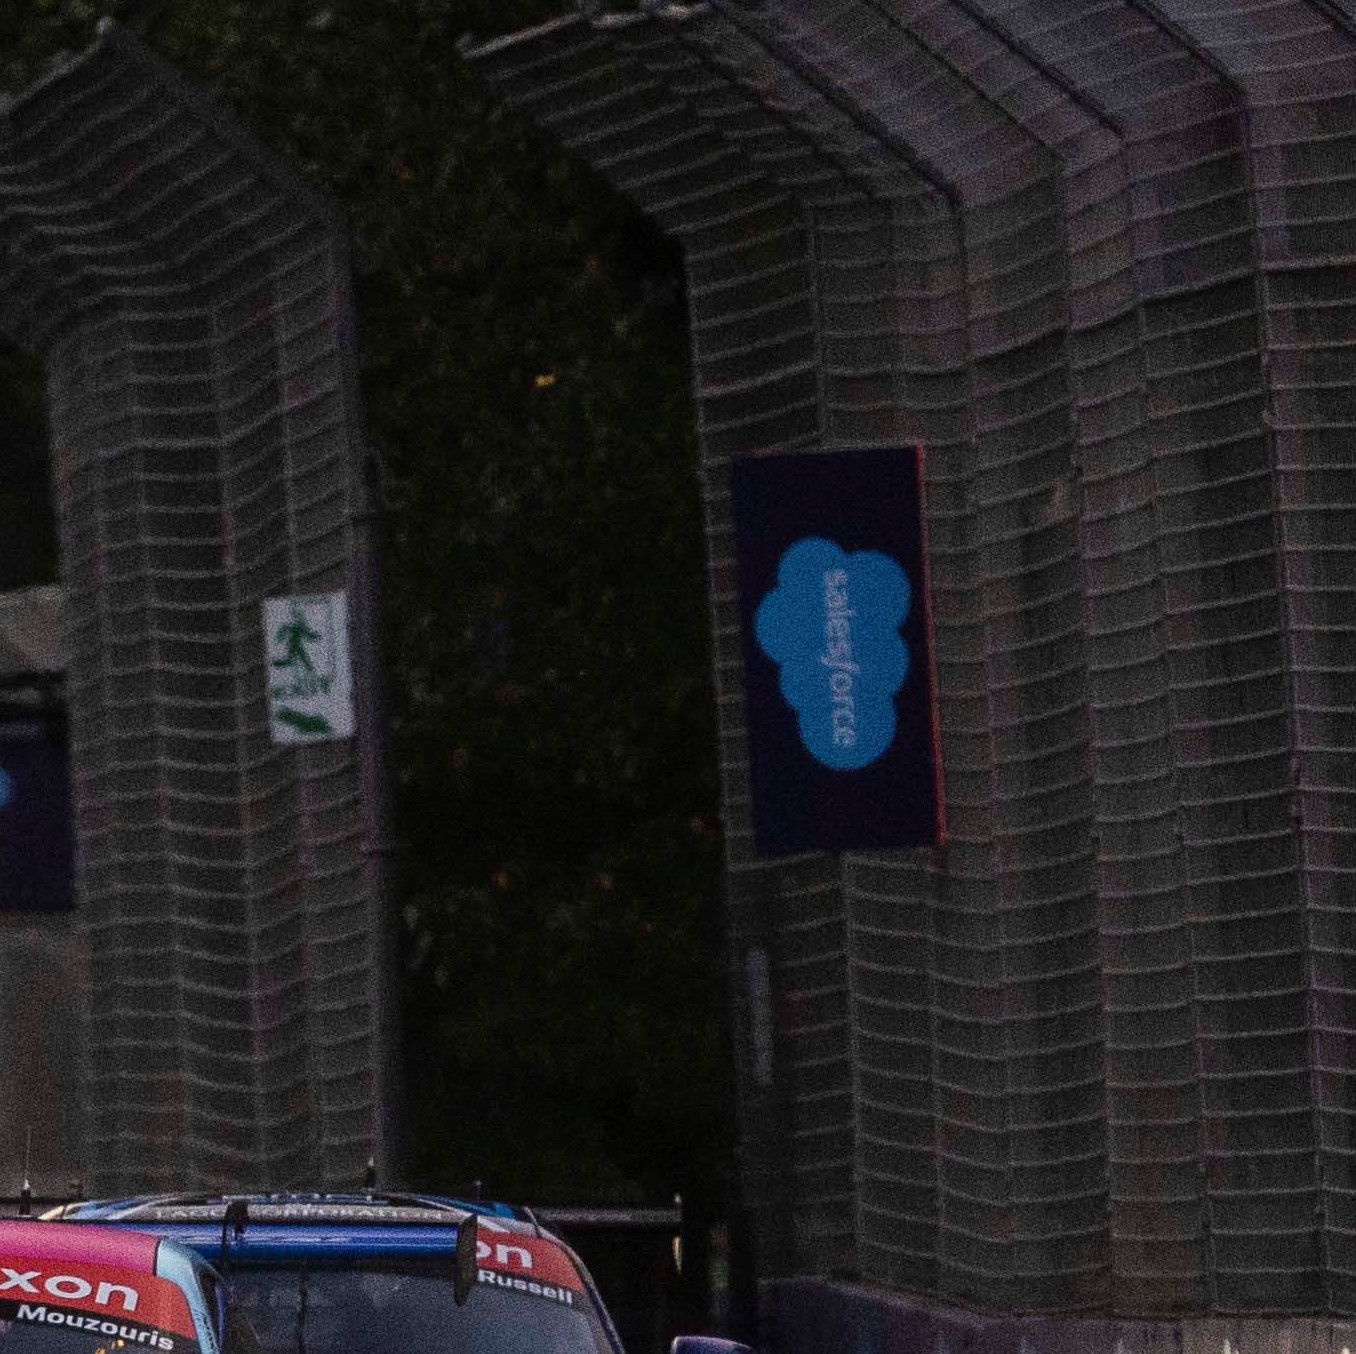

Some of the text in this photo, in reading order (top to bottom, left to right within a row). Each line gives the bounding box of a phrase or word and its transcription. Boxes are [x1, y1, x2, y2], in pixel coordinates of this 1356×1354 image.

[820, 570, 862, 748] salesforce
[476, 1268, 573, 1305] Russell
[17, 1304, 175, 1352] Mouzouris
